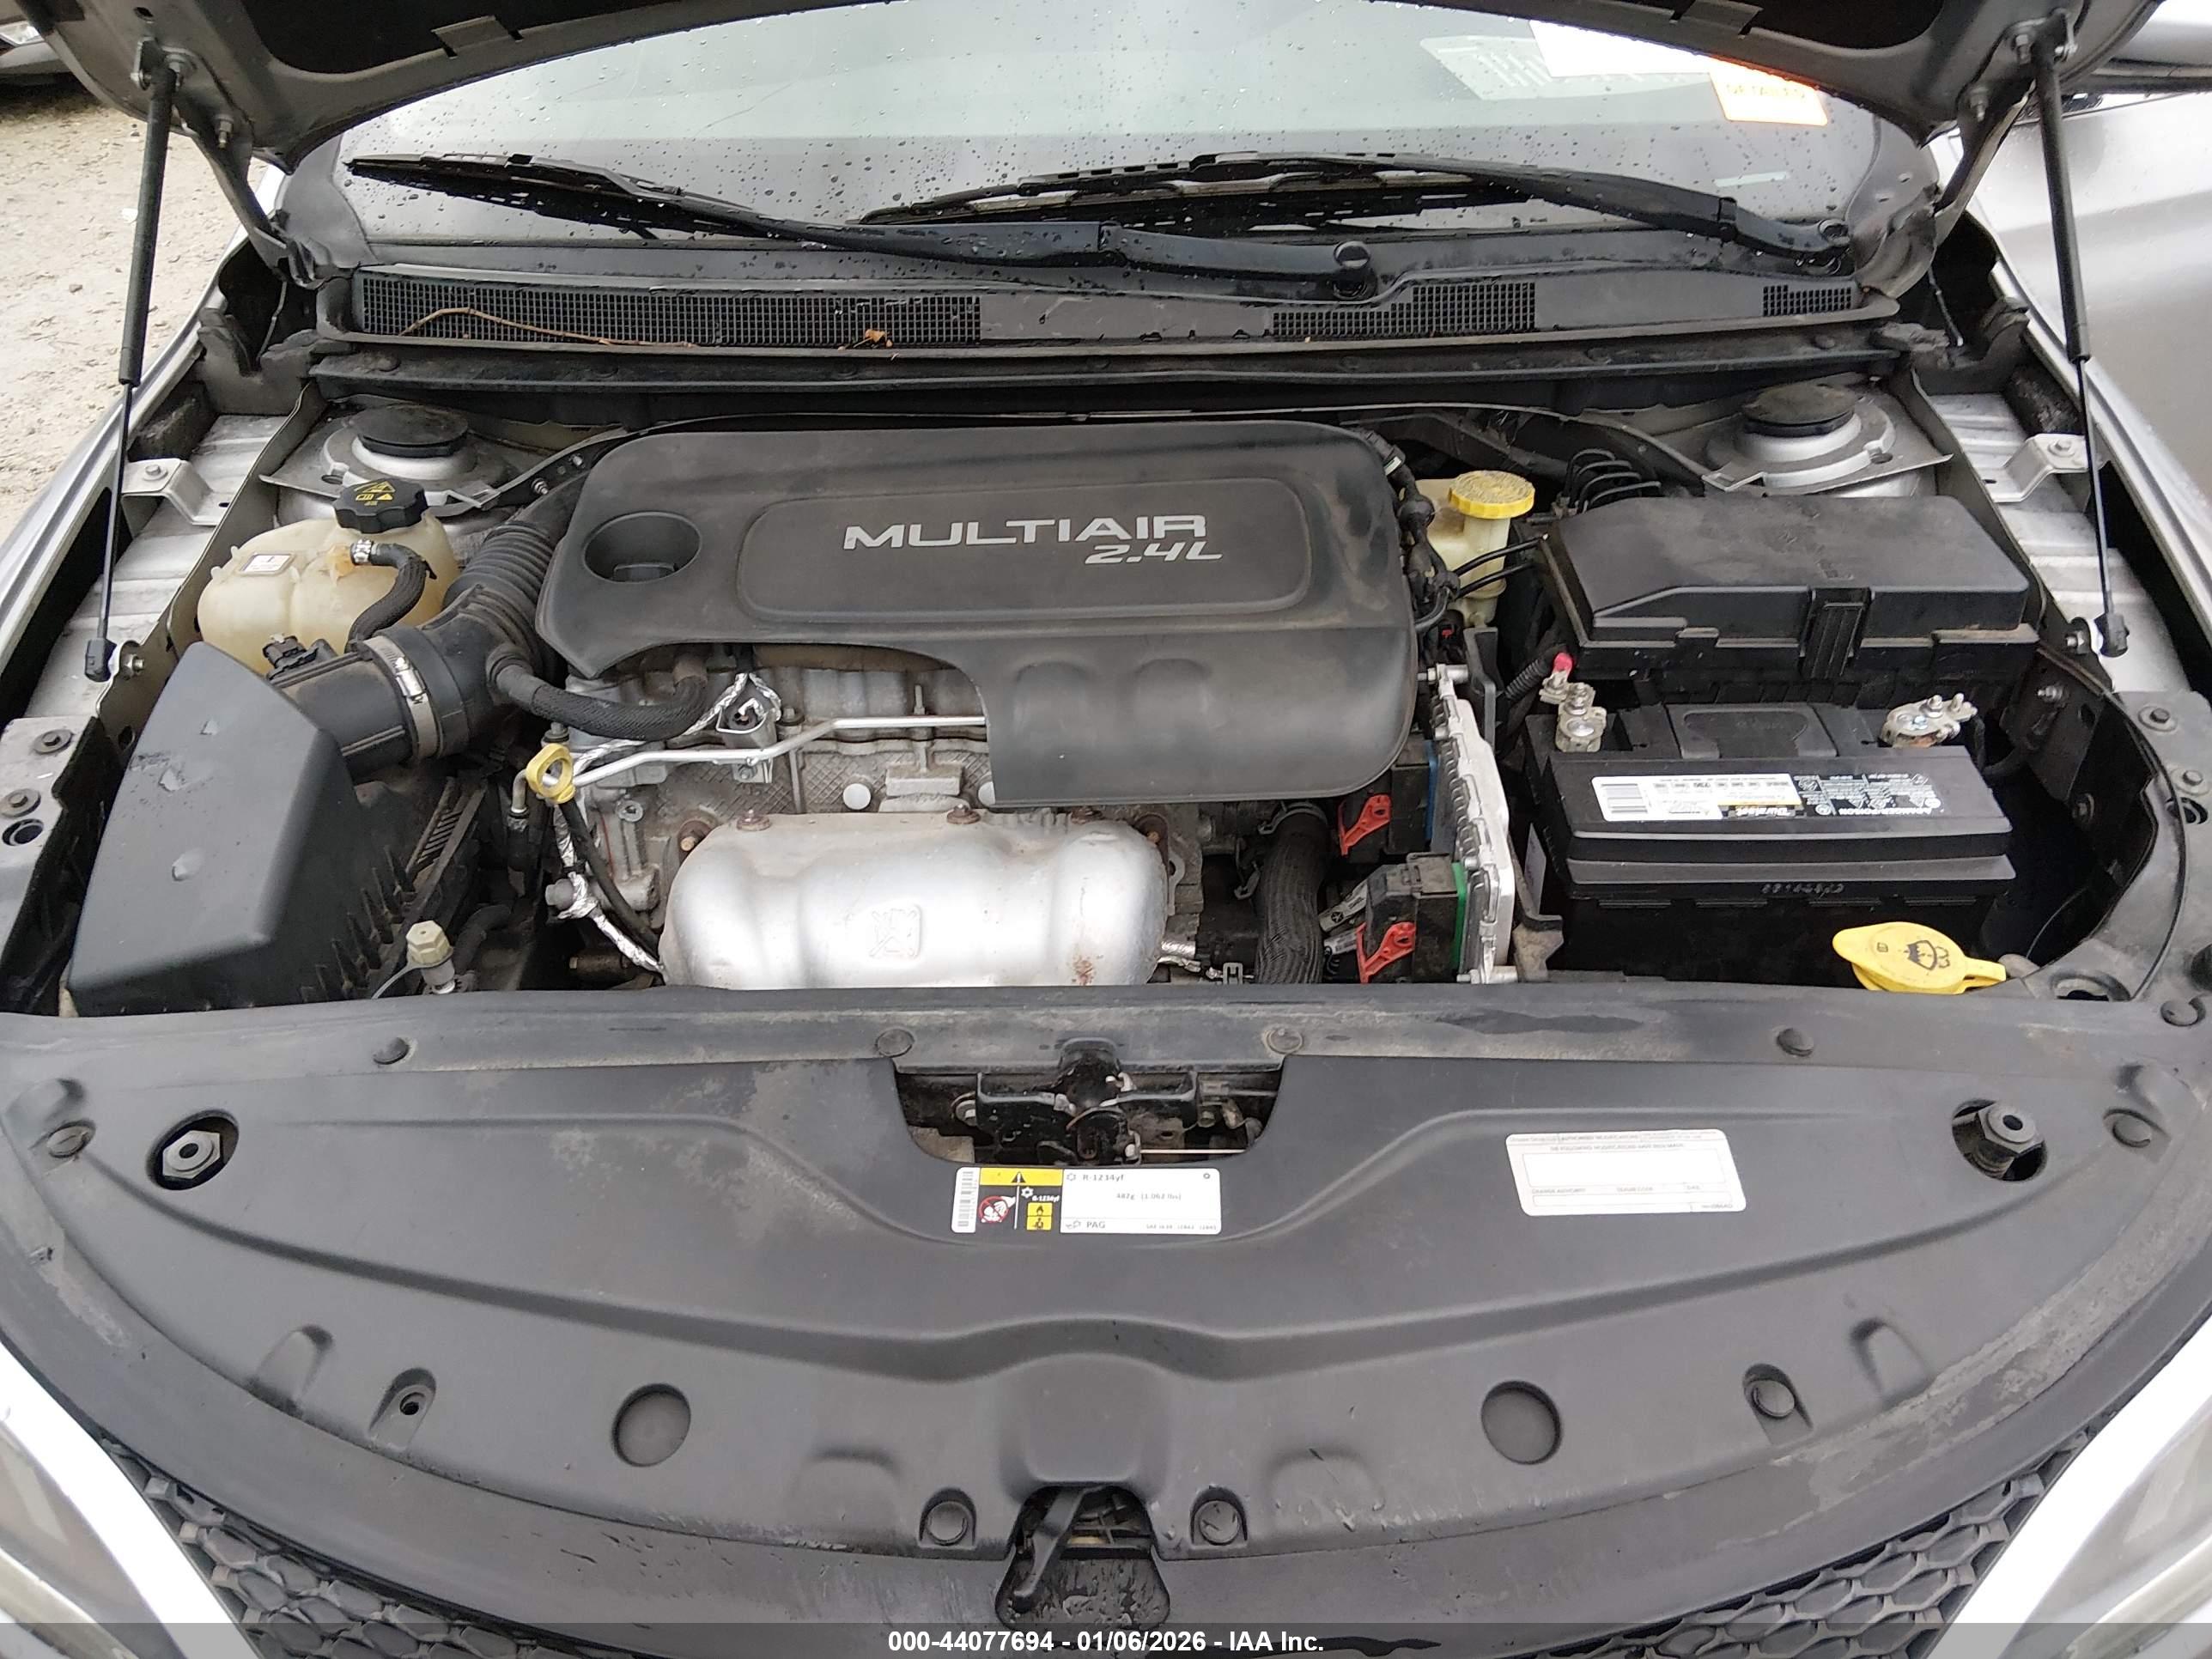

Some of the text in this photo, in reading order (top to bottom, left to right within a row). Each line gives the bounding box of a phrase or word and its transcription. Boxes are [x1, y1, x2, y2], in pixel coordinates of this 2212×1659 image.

[843, 515, 1206, 550] MULTIAIR
[1085, 541, 1223, 565] 2.4L
[1083, 1173, 1125, 1182] R-1234yf
[1086, 1220, 1106, 1230] PAG
